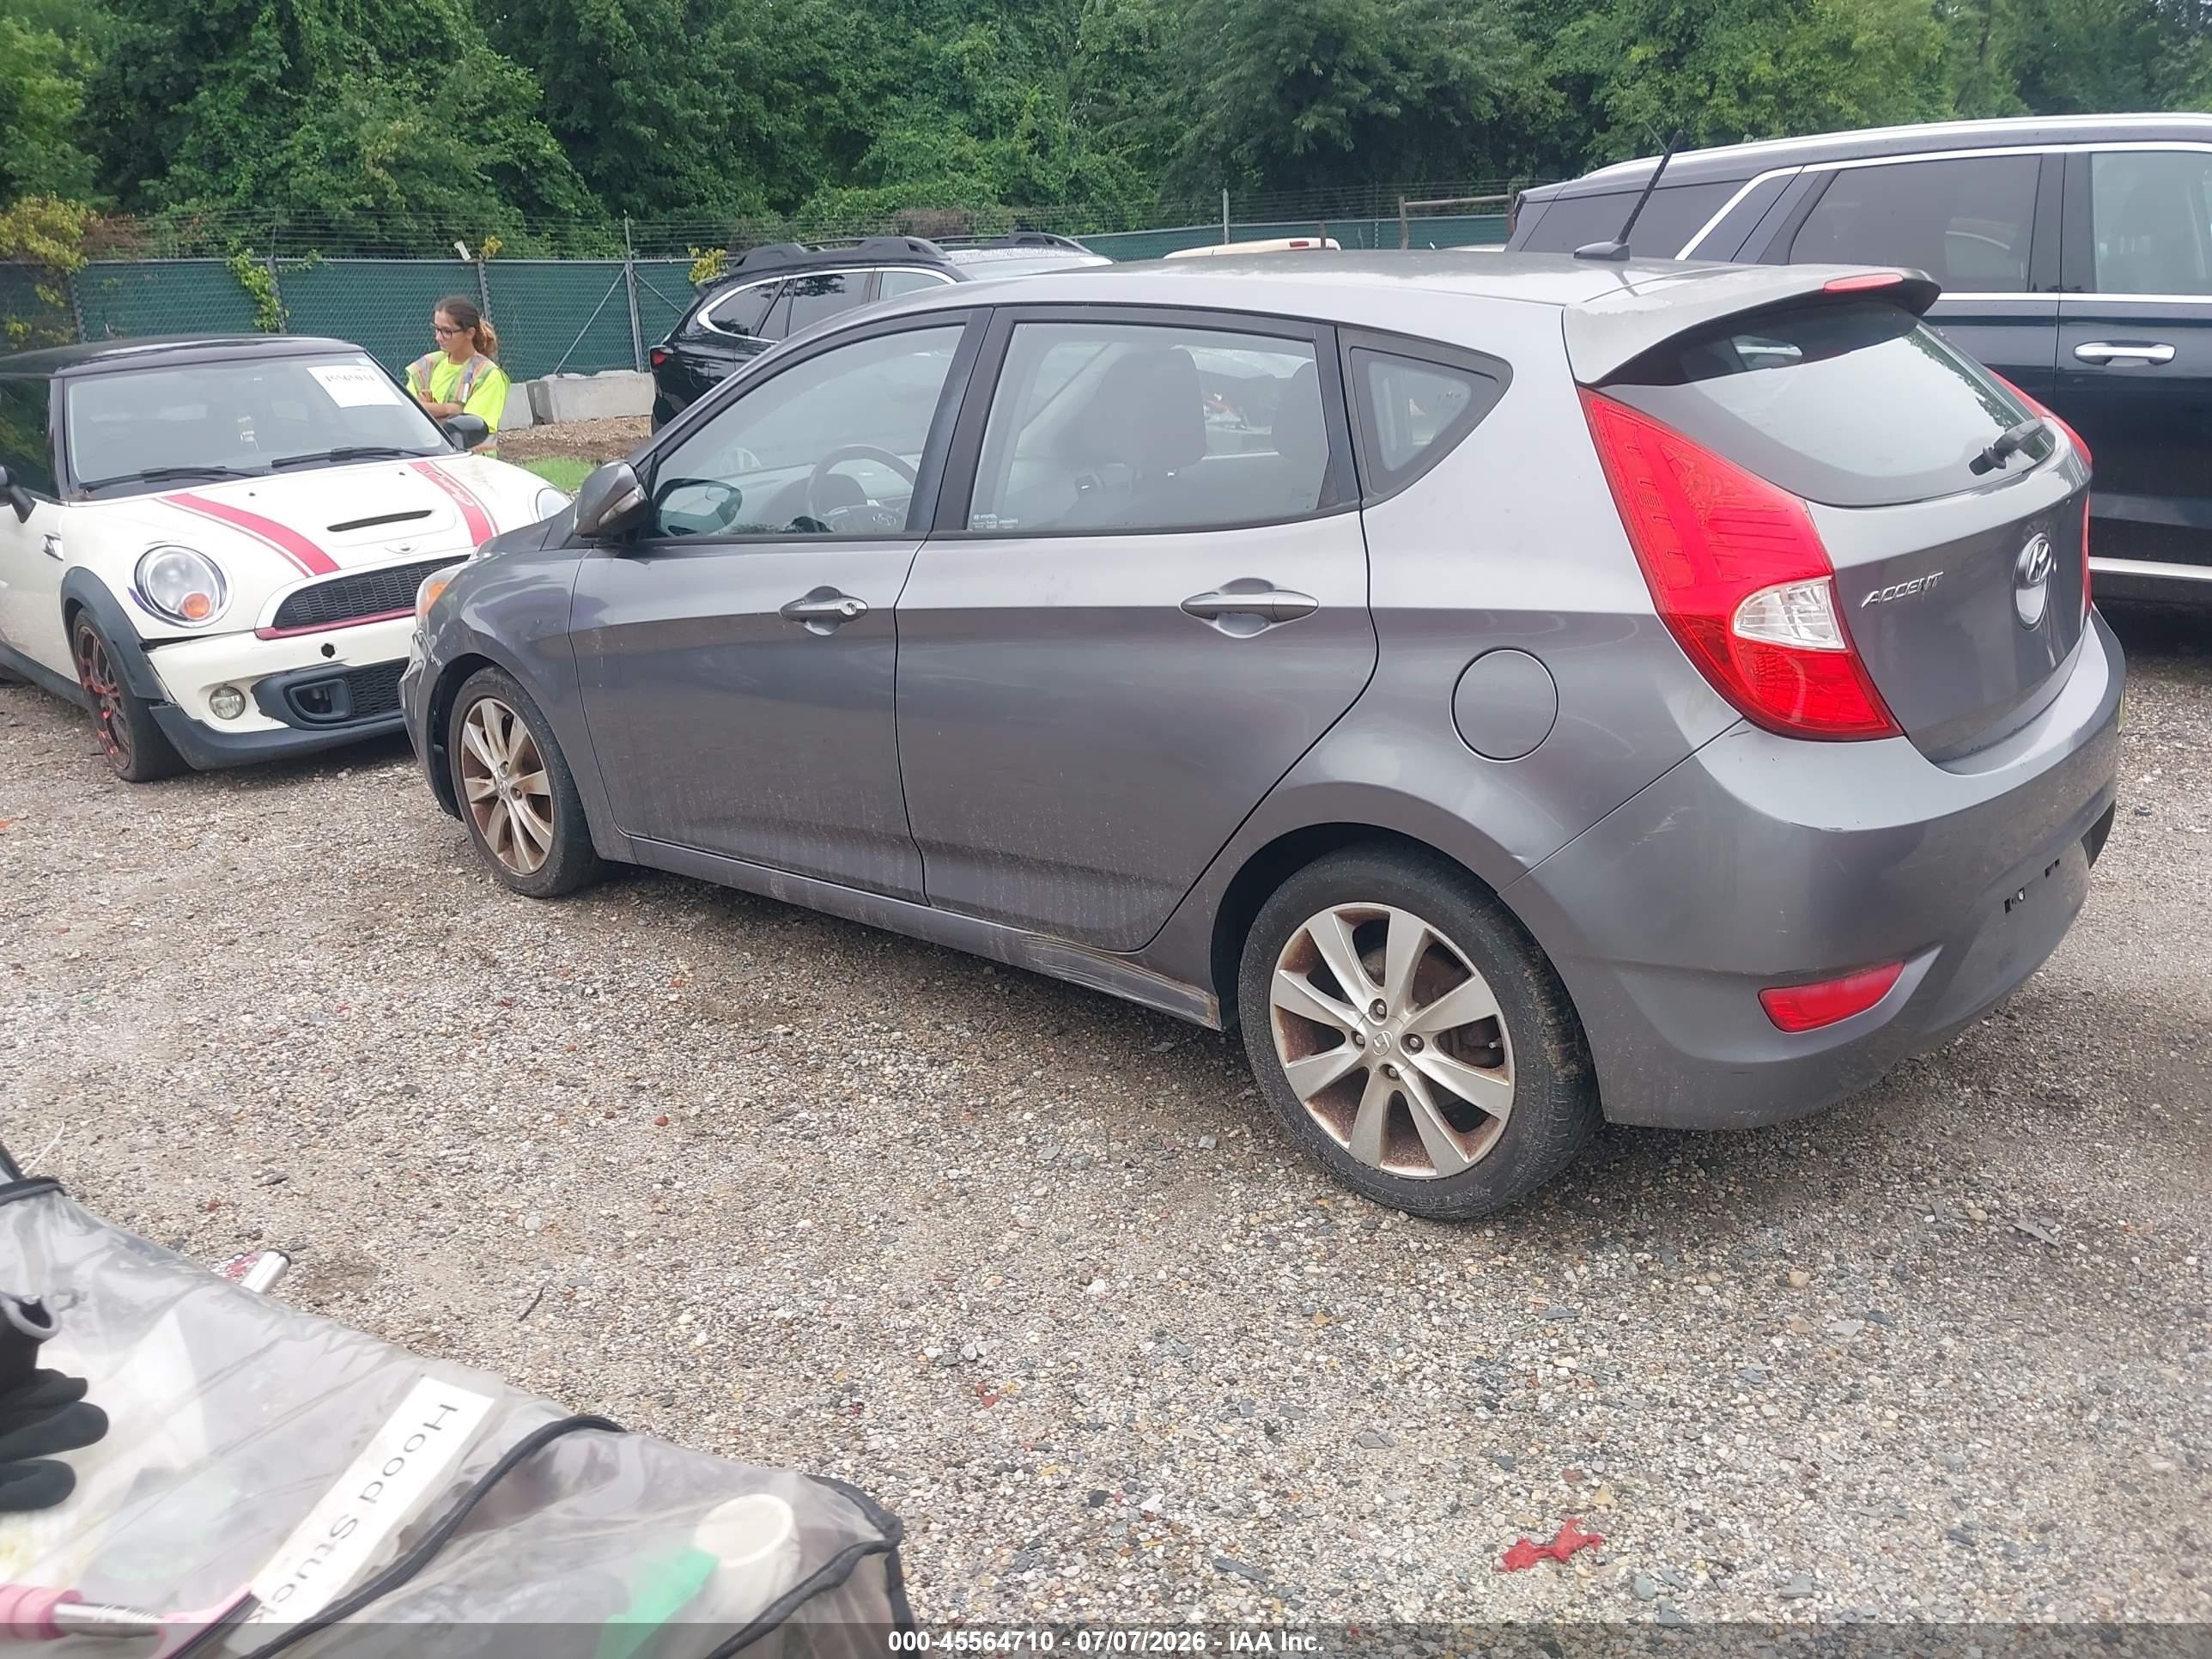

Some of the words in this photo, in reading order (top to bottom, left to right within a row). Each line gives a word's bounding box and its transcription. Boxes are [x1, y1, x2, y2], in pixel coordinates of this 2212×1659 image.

[1861, 571, 1944, 609] ACCENT
[360, 1404, 459, 1504] Hood
[247, 1514, 358, 1626] Stuck
